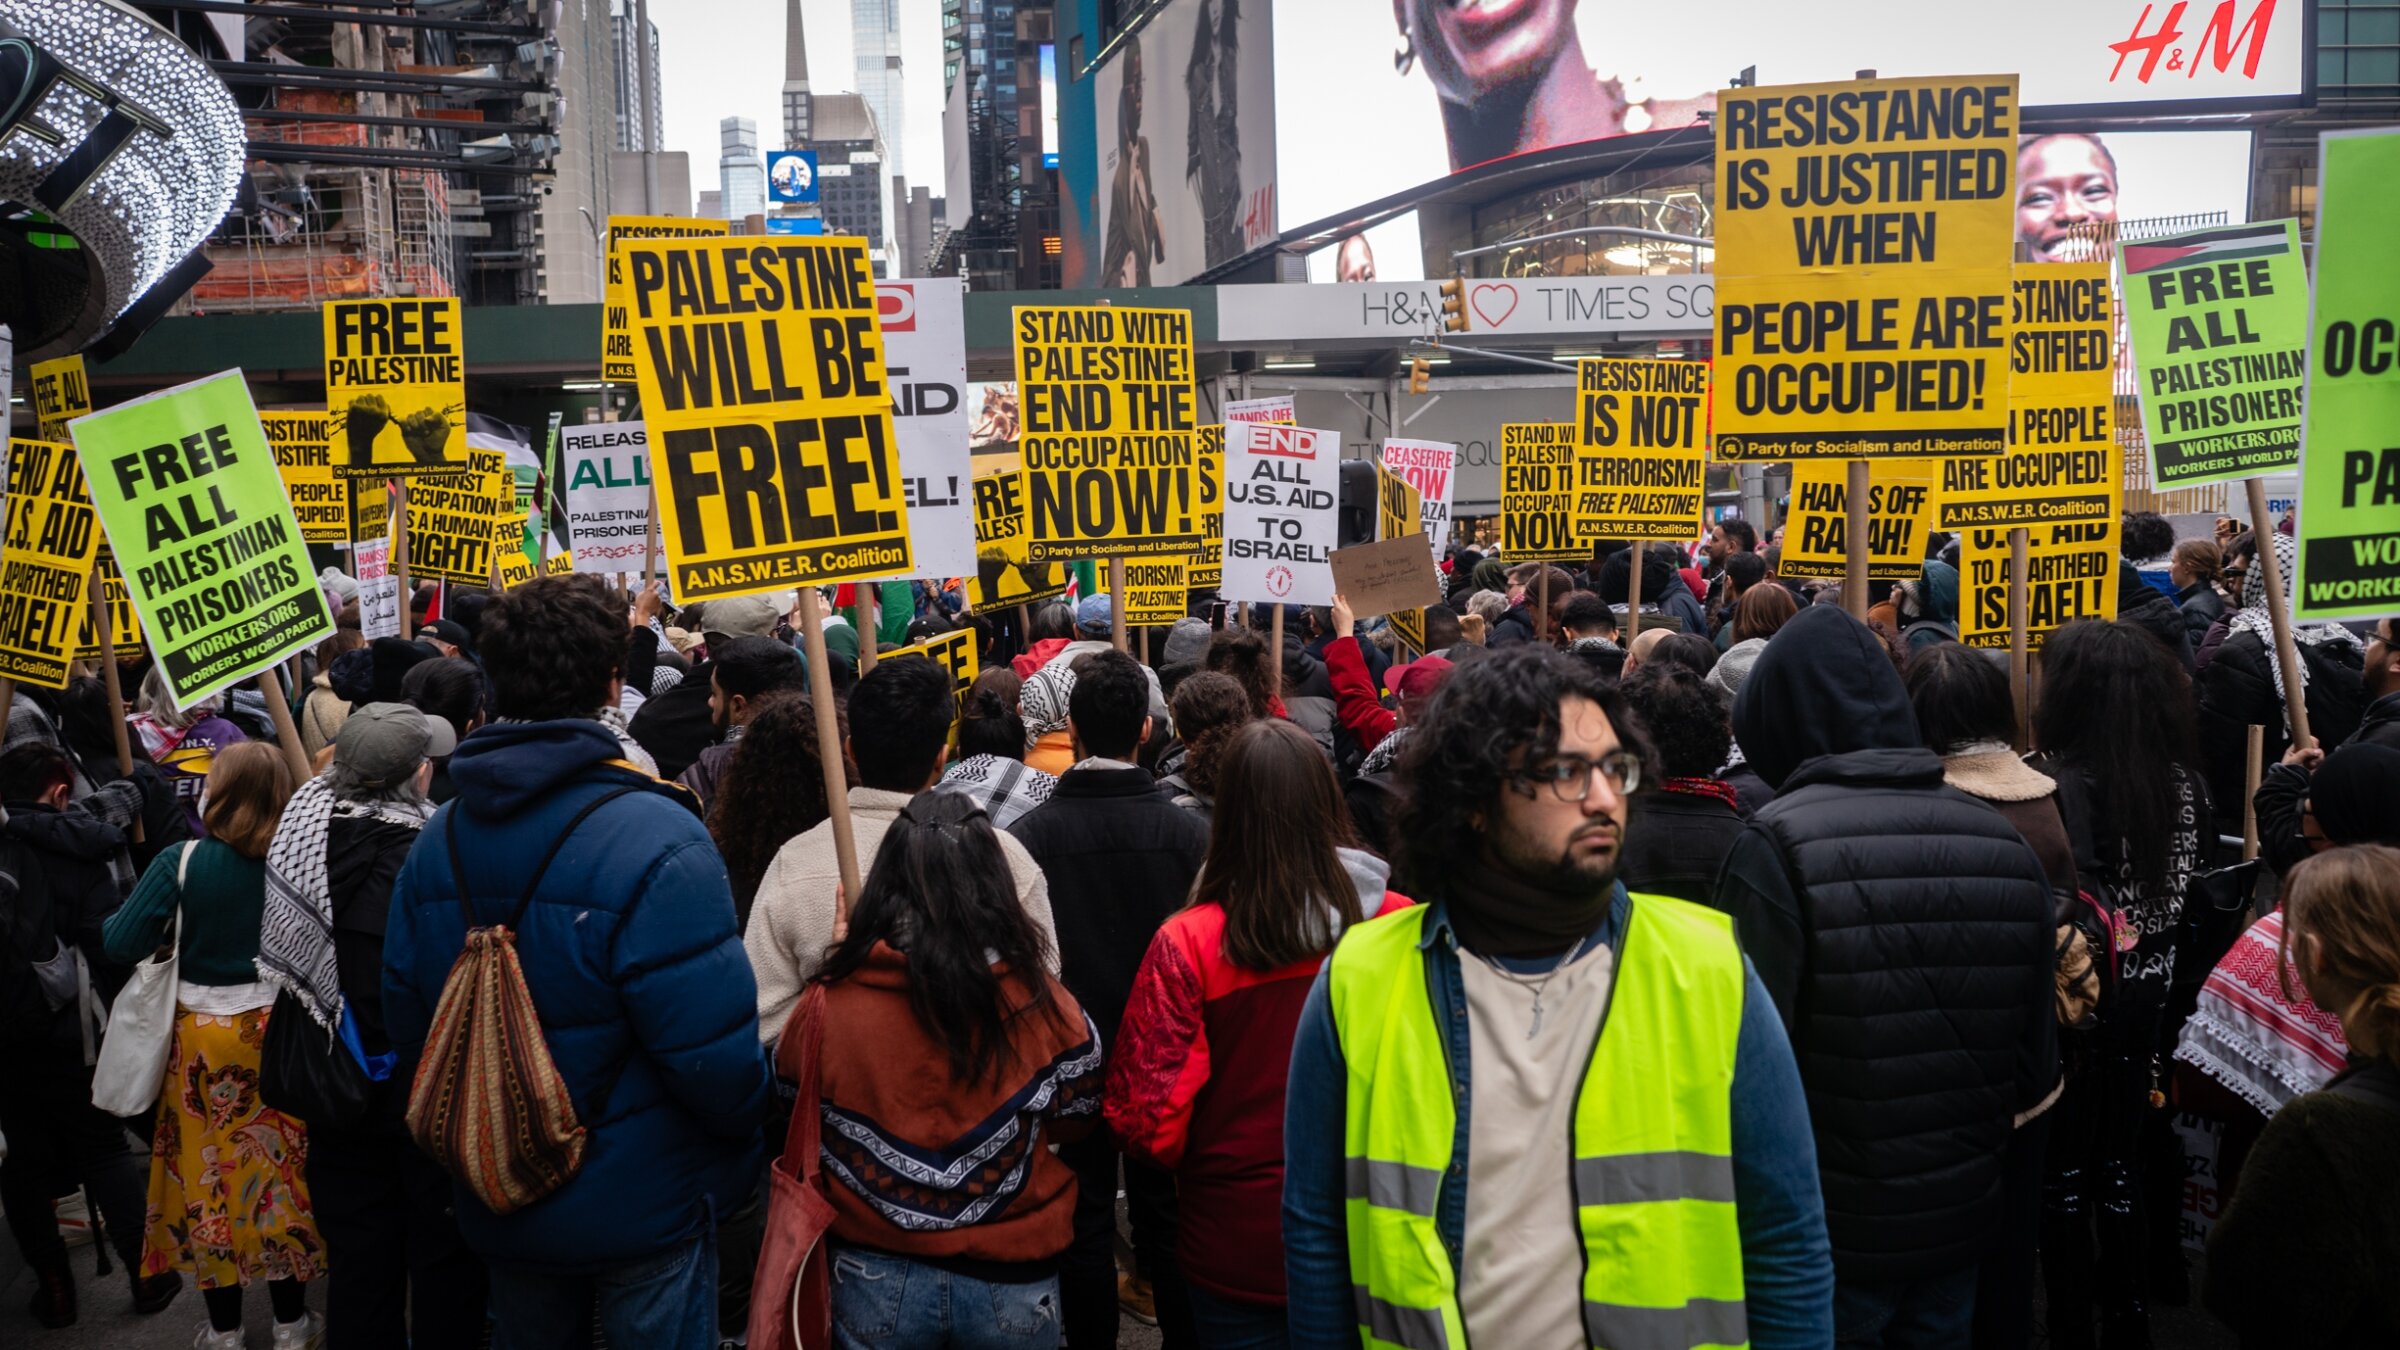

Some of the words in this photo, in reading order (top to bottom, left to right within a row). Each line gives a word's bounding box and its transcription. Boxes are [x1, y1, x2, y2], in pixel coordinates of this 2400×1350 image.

[2108, 0, 2277, 84] H&M
[1725, 86, 2010, 150] RESISTANCE
[1726, 159, 1770, 210] IS
[1780, 148, 2007, 207] JUSTIFIED
[1793, 211, 1936, 266] WHEN
[630, 246, 873, 318] PALESTINE
[2147, 260, 2274, 310] FREE
[1536, 285, 1650, 322] TIMES
[1666, 284, 1715, 319] SQ
[2013, 279, 2108, 324] STANCE
[335, 301, 452, 357] FREE
[1020, 310, 1114, 343] STAND
[1121, 312, 1187, 344] WITH
[1721, 298, 1899, 355] PEOPLE
[1910, 296, 2004, 349] ARE
[2165, 308, 2260, 354] ALL
[644, 319, 804, 411] WILL
[809, 316, 881, 399] BE
[1023, 346, 1188, 381] PALESTINE!
[2011, 329, 2108, 373] STIFIED
[2324, 318, 2400, 377] OC
[329, 356, 461, 386] PALESTINE
[608, 365, 635, 376] A.N.S.
[1583, 362, 1705, 393] RESISTANCE
[2151, 349, 2304, 396] PALESTINIAN
[35, 374, 62, 416] FREE
[62, 369, 88, 411] ALL
[1736, 359, 1985, 416] OCCUPIED!
[1025, 384, 1112, 432] END
[1122, 384, 1193, 431] THE
[1272, 407, 1292, 420] OFF
[1583, 394, 1619, 447] IS
[1630, 395, 1700, 448] NOT
[2159, 386, 2303, 435] PRISONERS
[262, 420, 330, 441] SISTANC
[566, 431, 647, 450] RELEAS
[1253, 427, 1316, 455] END
[1505, 426, 1554, 444] STAND
[1558, 426, 1576, 443] WI
[2024, 406, 2107, 444] PEOPLE
[110, 424, 239, 501] FREE
[274, 445, 331, 466] USTIFIE
[1025, 436, 1191, 469] OCCUPATION
[1385, 446, 1453, 469] CEASEFIRE
[1505, 445, 1576, 464] PALESTIN
[1748, 441, 1788, 457] Party
[1792, 440, 1812, 454] for
[1814, 438, 1889, 453] Socialism
[1892, 438, 1921, 452] and
[1925, 437, 2001, 452] Liberation
[8, 443, 52, 497] END
[50, 448, 92, 505] AL
[347, 467, 367, 476] Party
[368, 466, 378, 474] for
[379, 465, 412, 474] Socialism
[413, 465, 426, 473] and
[428, 464, 466, 473] Liberation
[569, 455, 650, 491] ALL
[1250, 459, 1311, 485] ALL
[1506, 466, 1550, 492] END
[1579, 457, 1700, 488] TERRORISM!
[1942, 458, 1988, 491] ARE
[1995, 450, 2107, 489] OCCUPIED!
[2164, 455, 2234, 477] WORKERS
[2238, 452, 2283, 467] WORLD
[2342, 448, 2400, 508] PA
[291, 484, 344, 501] PEOPLE
[416, 474, 485, 492] AGAINST
[662, 414, 899, 556] FREE!
[904, 476, 959, 507] EL!
[1228, 482, 1282, 506] U.S.
[1287, 489, 1334, 510] AID
[1382, 470, 1407, 522] END
[1399, 467, 1447, 500] OW
[1799, 482, 1882, 514] HANS
[1890, 485, 1927, 514] OFF
[144, 484, 238, 552] ALL
[294, 506, 345, 523] CUPIED!
[1029, 468, 1192, 539] NOW!
[1421, 502, 1447, 521] AZA
[1504, 494, 1572, 512] OCCUPATI
[1577, 493, 1616, 514] FREE
[1618, 493, 1700, 515] PALESTINE!
[1945, 505, 2036, 523] A.N.S.W.E.R.
[2039, 502, 2105, 517] Coalition
[37, 503, 94, 560] AID
[304, 530, 345, 539] Coalition
[418, 512, 428, 530] A
[432, 513, 493, 539] HUMAN
[975, 515, 1024, 543] ALEST
[1257, 517, 1302, 541] TO
[1580, 523, 1646, 534] A.N.S.W.E.R.
[1649, 523, 1695, 535] Coalition
[1801, 516, 1909, 555] RAAH!
[137, 513, 288, 601] PALESTINIAN
[1048, 547, 1073, 557] Party
[1075, 545, 1089, 554] for
[1091, 543, 1136, 553] Socialism
[1138, 542, 1153, 551] and
[1155, 541, 1200, 551] Liberation
[1229, 539, 1330, 563] ISRAEL!
[2353, 537, 2400, 566] WO
[4, 561, 82, 603] APARTHEID
[502, 556, 574, 584] POLICAL
[686, 557, 818, 591] A.N.S.W.E.R.
[821, 545, 903, 572] Coalition
[1099, 565, 1184, 588] TRORISM!
[1191, 571, 1222, 583] A.N.S.
[1798, 566, 1818, 577] Party
[1820, 566, 1831, 575] for
[1870, 568, 1882, 576] and
[1884, 568, 1920, 577] Liberation
[1971, 559, 1994, 585] TO
[155, 554, 300, 643] PRISONERS
[1128, 591, 1185, 607] PALESTINE!
[1974, 579, 2103, 631] ISAEL!
[2310, 577, 2400, 601] WORKE
[0, 593, 74, 657] RAEL!
[185, 600, 301, 664] WORKERS.ORG
[1126, 612, 1150, 621] W.E.R.
[1151, 611, 1184, 621] Coalition
[179, 654, 242, 690] WORKERS
[241, 632, 286, 661] WORLD
[284, 613, 321, 641] PARTY
[13, 657, 64, 679] Coalition
